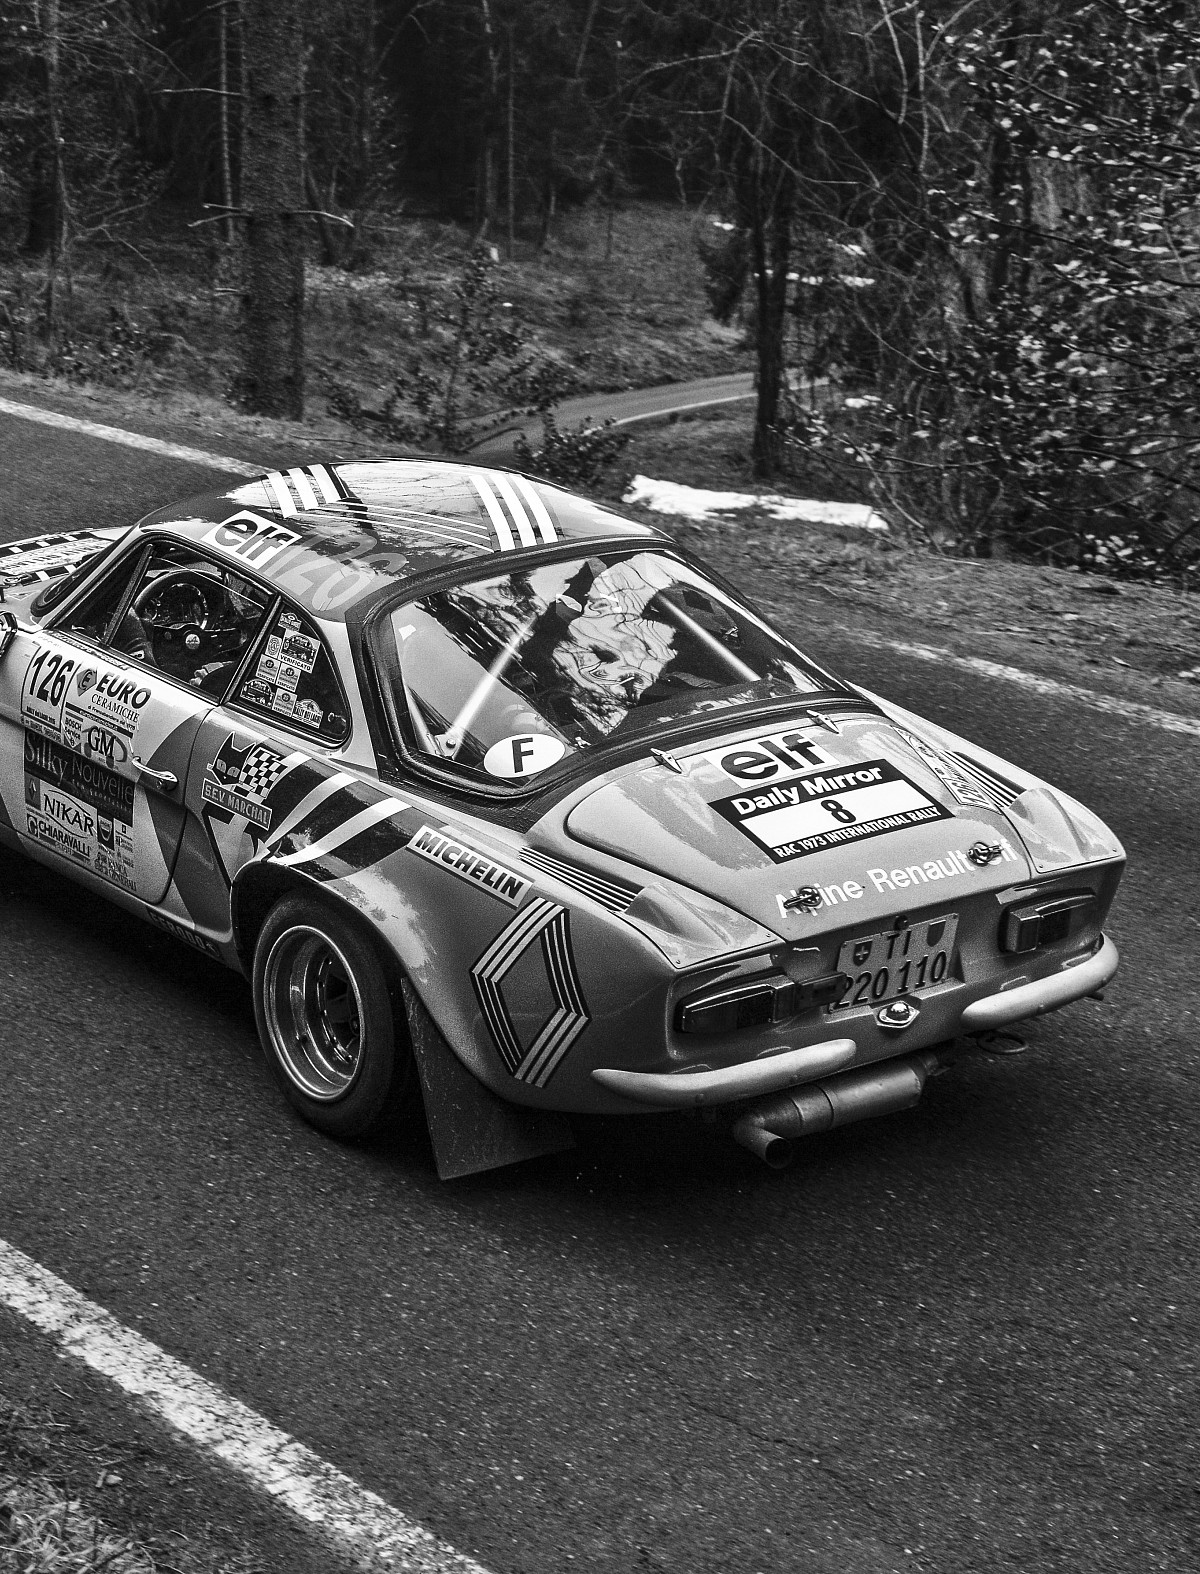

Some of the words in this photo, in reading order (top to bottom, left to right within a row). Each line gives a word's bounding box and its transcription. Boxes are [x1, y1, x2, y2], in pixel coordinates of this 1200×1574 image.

[214, 519, 294, 561] elf
[29, 649, 75, 707] 126
[280, 654, 312, 671] VERIFICATO
[91, 693, 141, 723] CERAMICHE
[95, 670, 152, 710] EURO
[64, 717, 81, 731] BOSCH
[64, 727, 81, 741] Service
[87, 726, 117, 757] GM
[25, 731, 68, 787] Silky
[72, 753, 134, 805] Nouvelle
[511, 737, 534, 774] F
[721, 733, 825, 780] elf
[227, 794, 268, 825] MARCHAL
[730, 786, 801, 815] Daily
[800, 766, 882, 796] Mirror
[43, 793, 94, 836] NIKAR
[820, 799, 857, 824] 8
[38, 820, 90, 857] CHIARAVALLI
[773, 842, 801, 858] RAC
[798, 833, 827, 850] 1973
[824, 814, 910, 844] INTERNATIONAL
[907, 806, 941, 824] RALLY
[414, 831, 525, 900] MICHELIN
[866, 849, 976, 892] Renault
[887, 930, 912, 960] TI
[832, 967, 890, 1010] 220
[898, 950, 947, 992] 110
